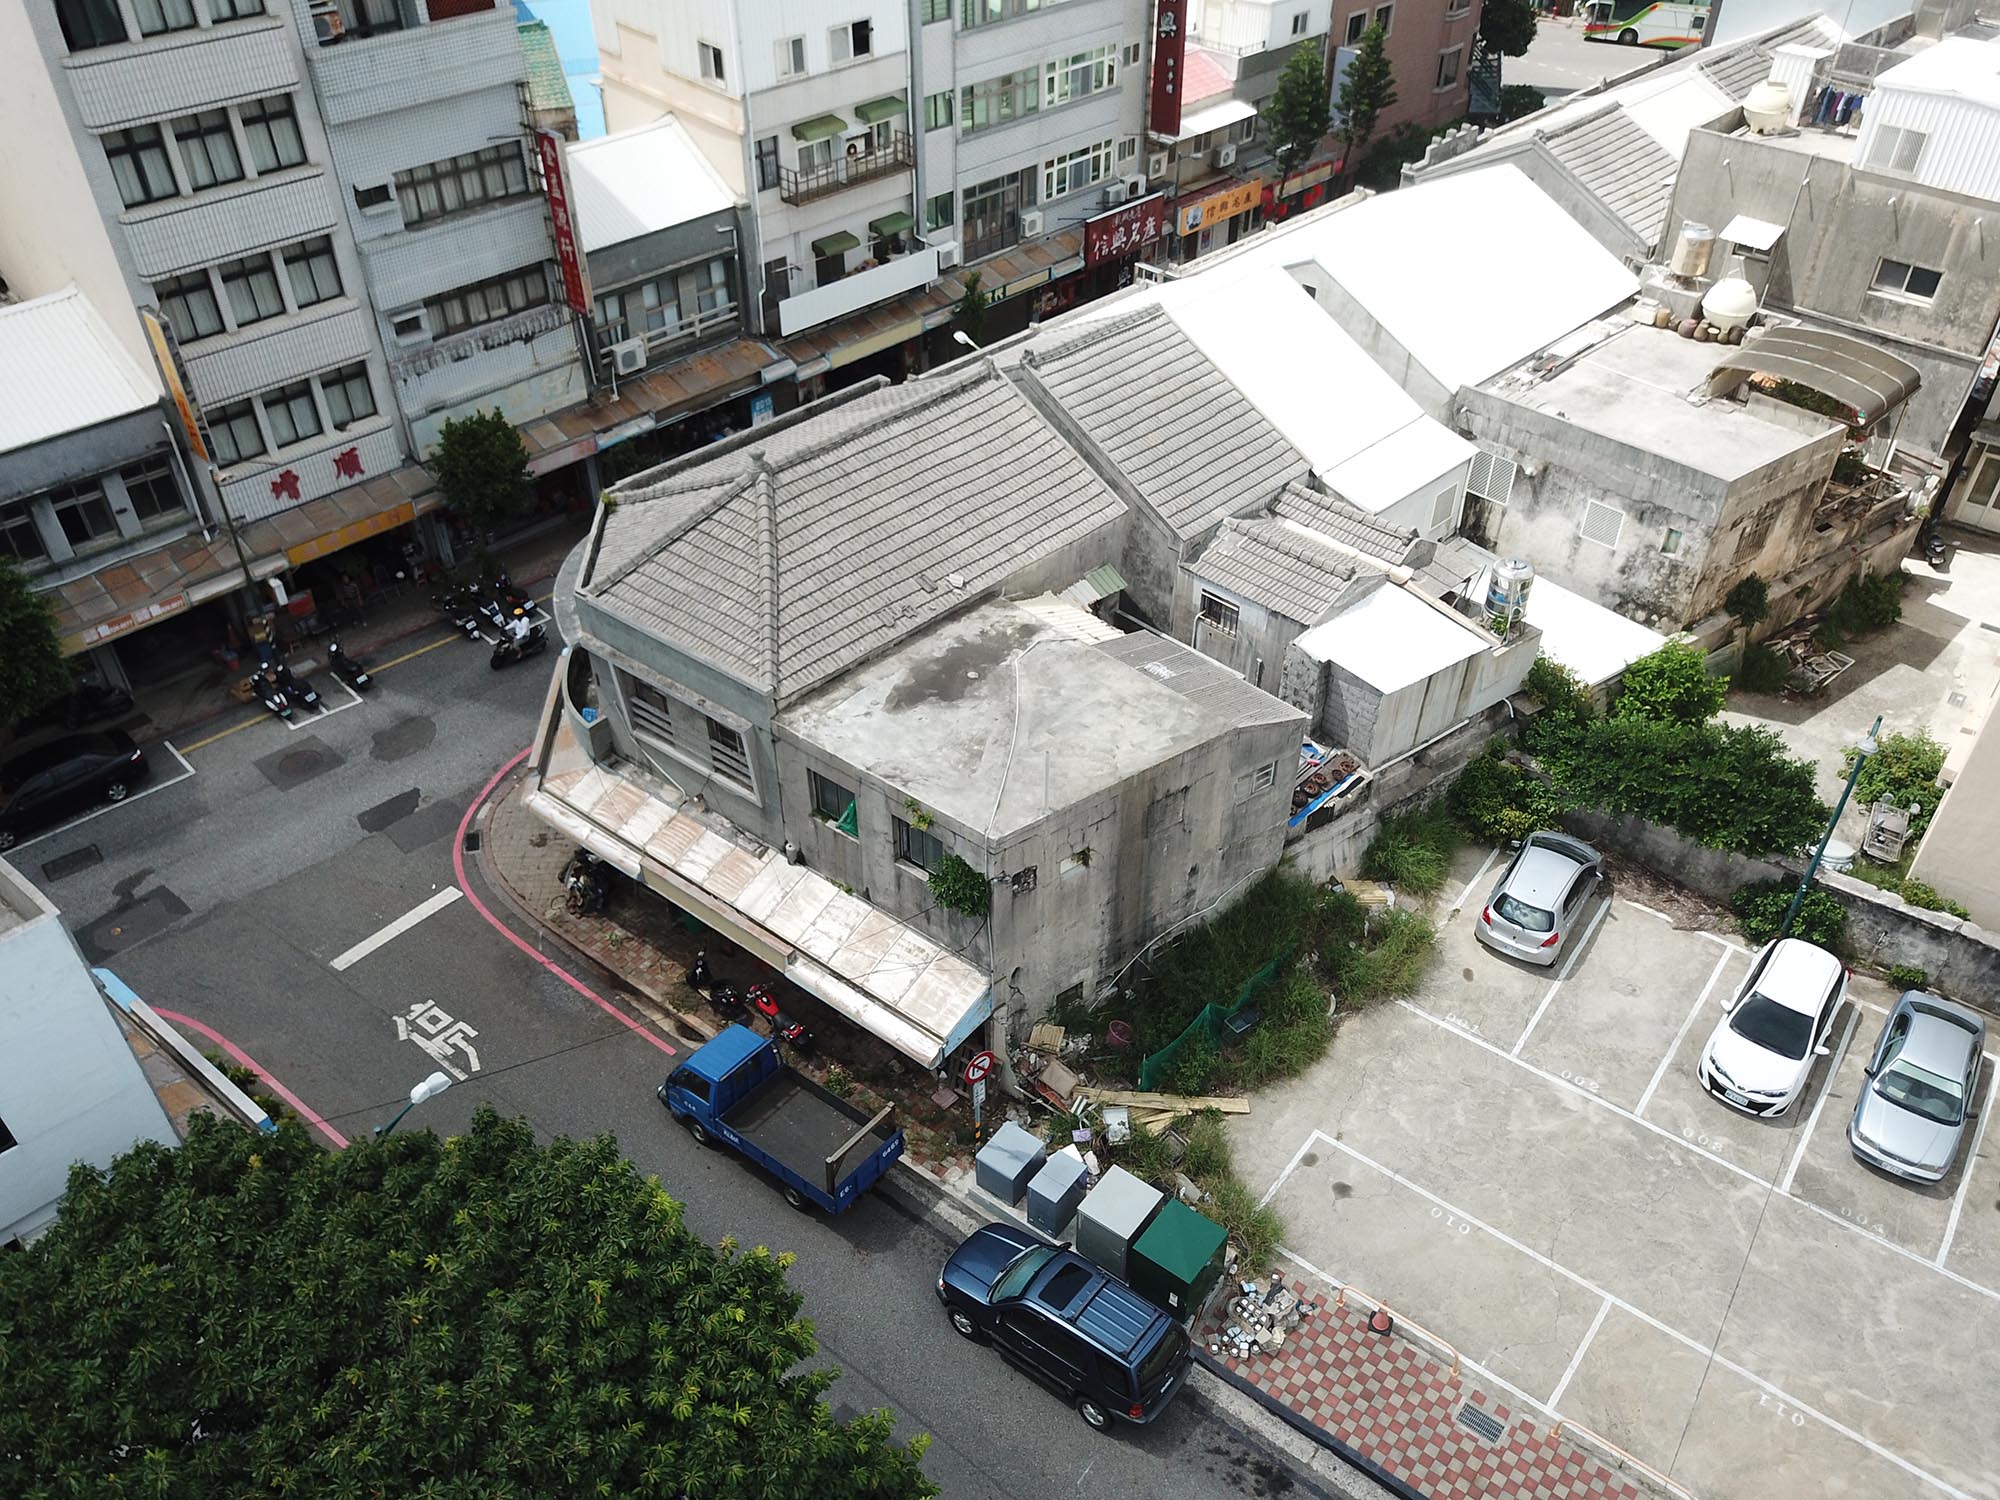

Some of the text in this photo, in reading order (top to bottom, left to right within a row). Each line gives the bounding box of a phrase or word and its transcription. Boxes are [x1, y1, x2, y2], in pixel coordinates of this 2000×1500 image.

[392, 999, 481, 1081] 停
[1561, 1070, 1600, 1093] 002
[1431, 1207, 1471, 1234] 010
[1759, 1391, 1805, 1427] 011
